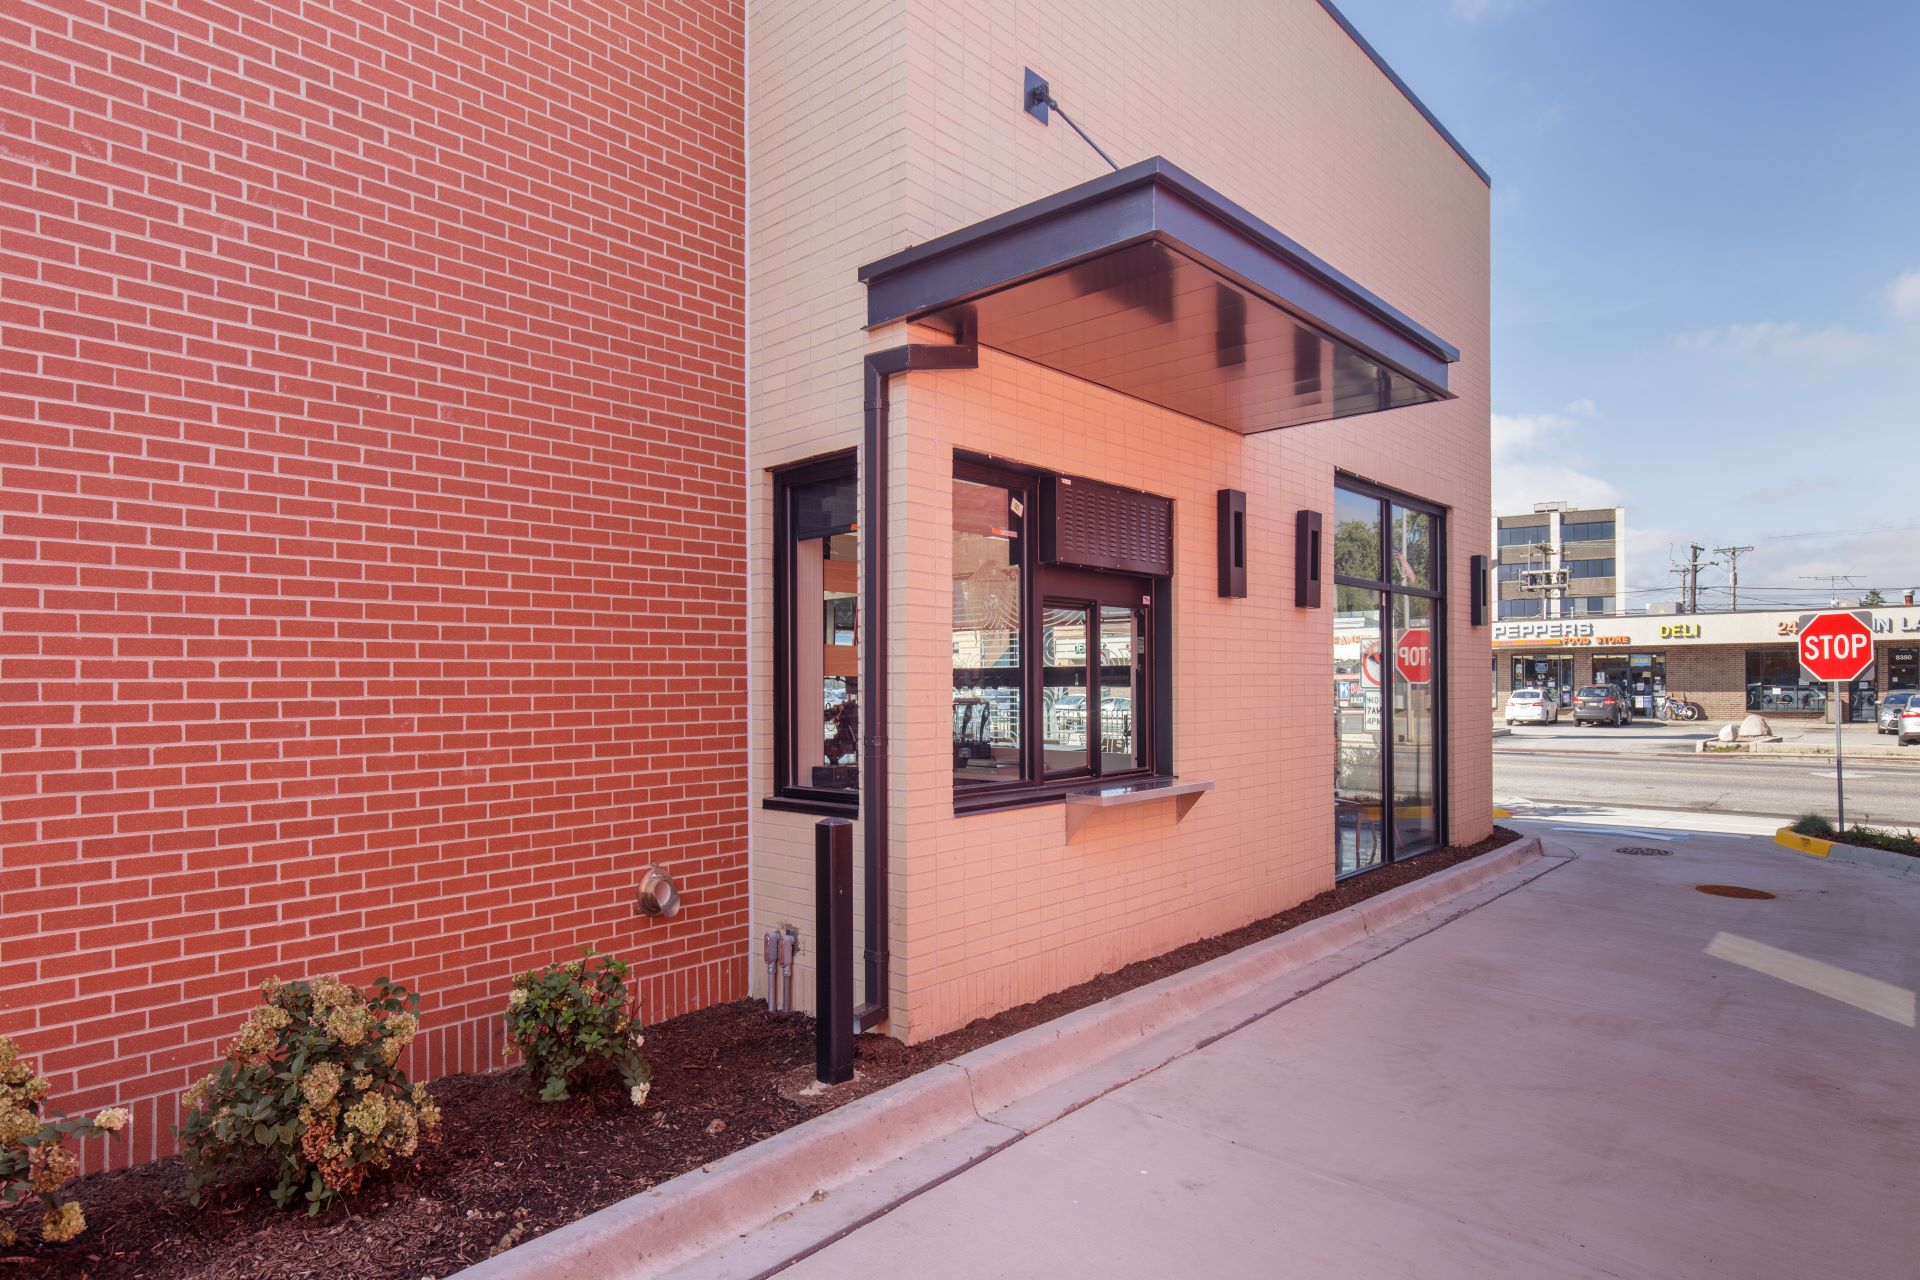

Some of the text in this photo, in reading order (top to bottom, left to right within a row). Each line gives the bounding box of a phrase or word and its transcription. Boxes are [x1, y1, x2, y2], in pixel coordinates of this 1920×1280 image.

[1494, 622, 1593, 639] PEPPERS
[1659, 623, 1701, 639] DELI
[1561, 635, 1631, 646] FOOD STORE
[1804, 633, 1867, 661] STOP
